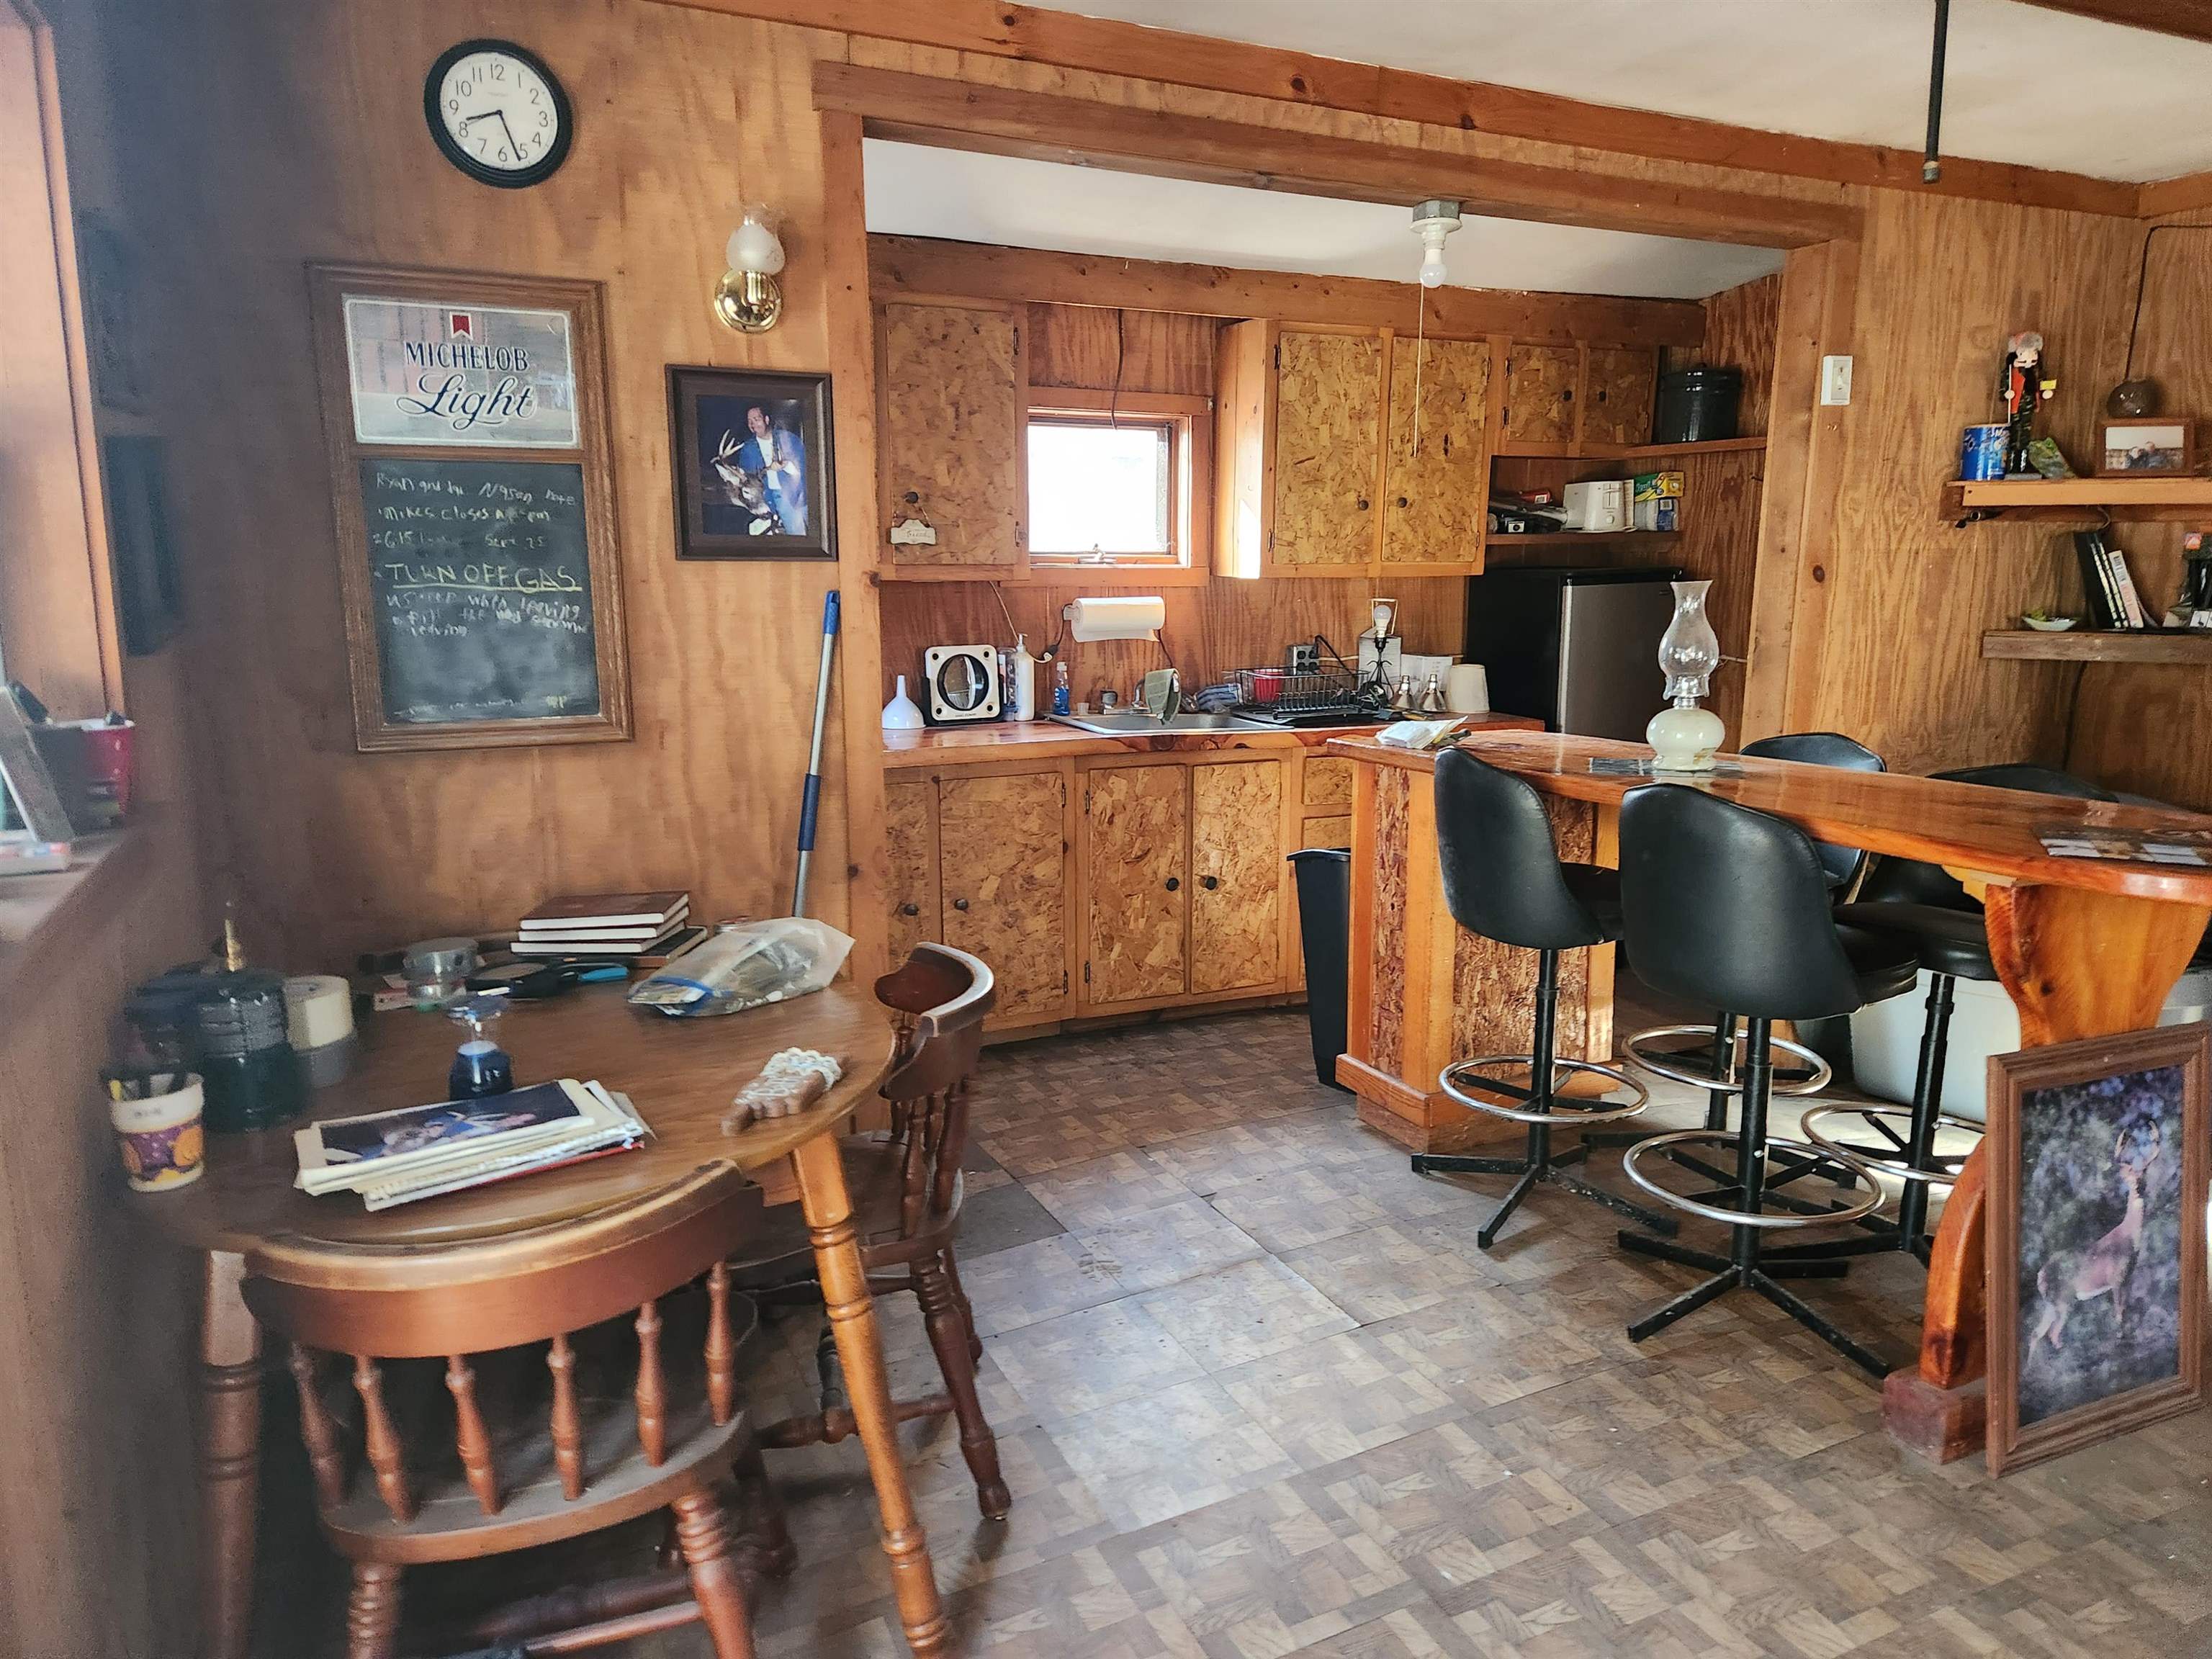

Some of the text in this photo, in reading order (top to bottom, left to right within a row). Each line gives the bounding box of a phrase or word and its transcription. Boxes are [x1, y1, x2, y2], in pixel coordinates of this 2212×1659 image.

[472, 66, 482, 83] 11
[490, 63, 505, 81] 12
[517, 72, 522, 89] 1
[455, 80, 472, 97] 10
[529, 88, 540, 105] 2
[449, 99, 459, 115] 9
[539, 110, 549, 127] 3
[459, 121, 469, 138] 8
[477, 138, 487, 155] 7
[531, 132, 541, 148] 4
[498, 146, 508, 162] 6
[518, 143, 529, 160] 5
[404, 341, 529, 372] MICHELOB
[395, 373, 536, 431] Light
[385, 562, 577, 593] TURN OFF GAS
